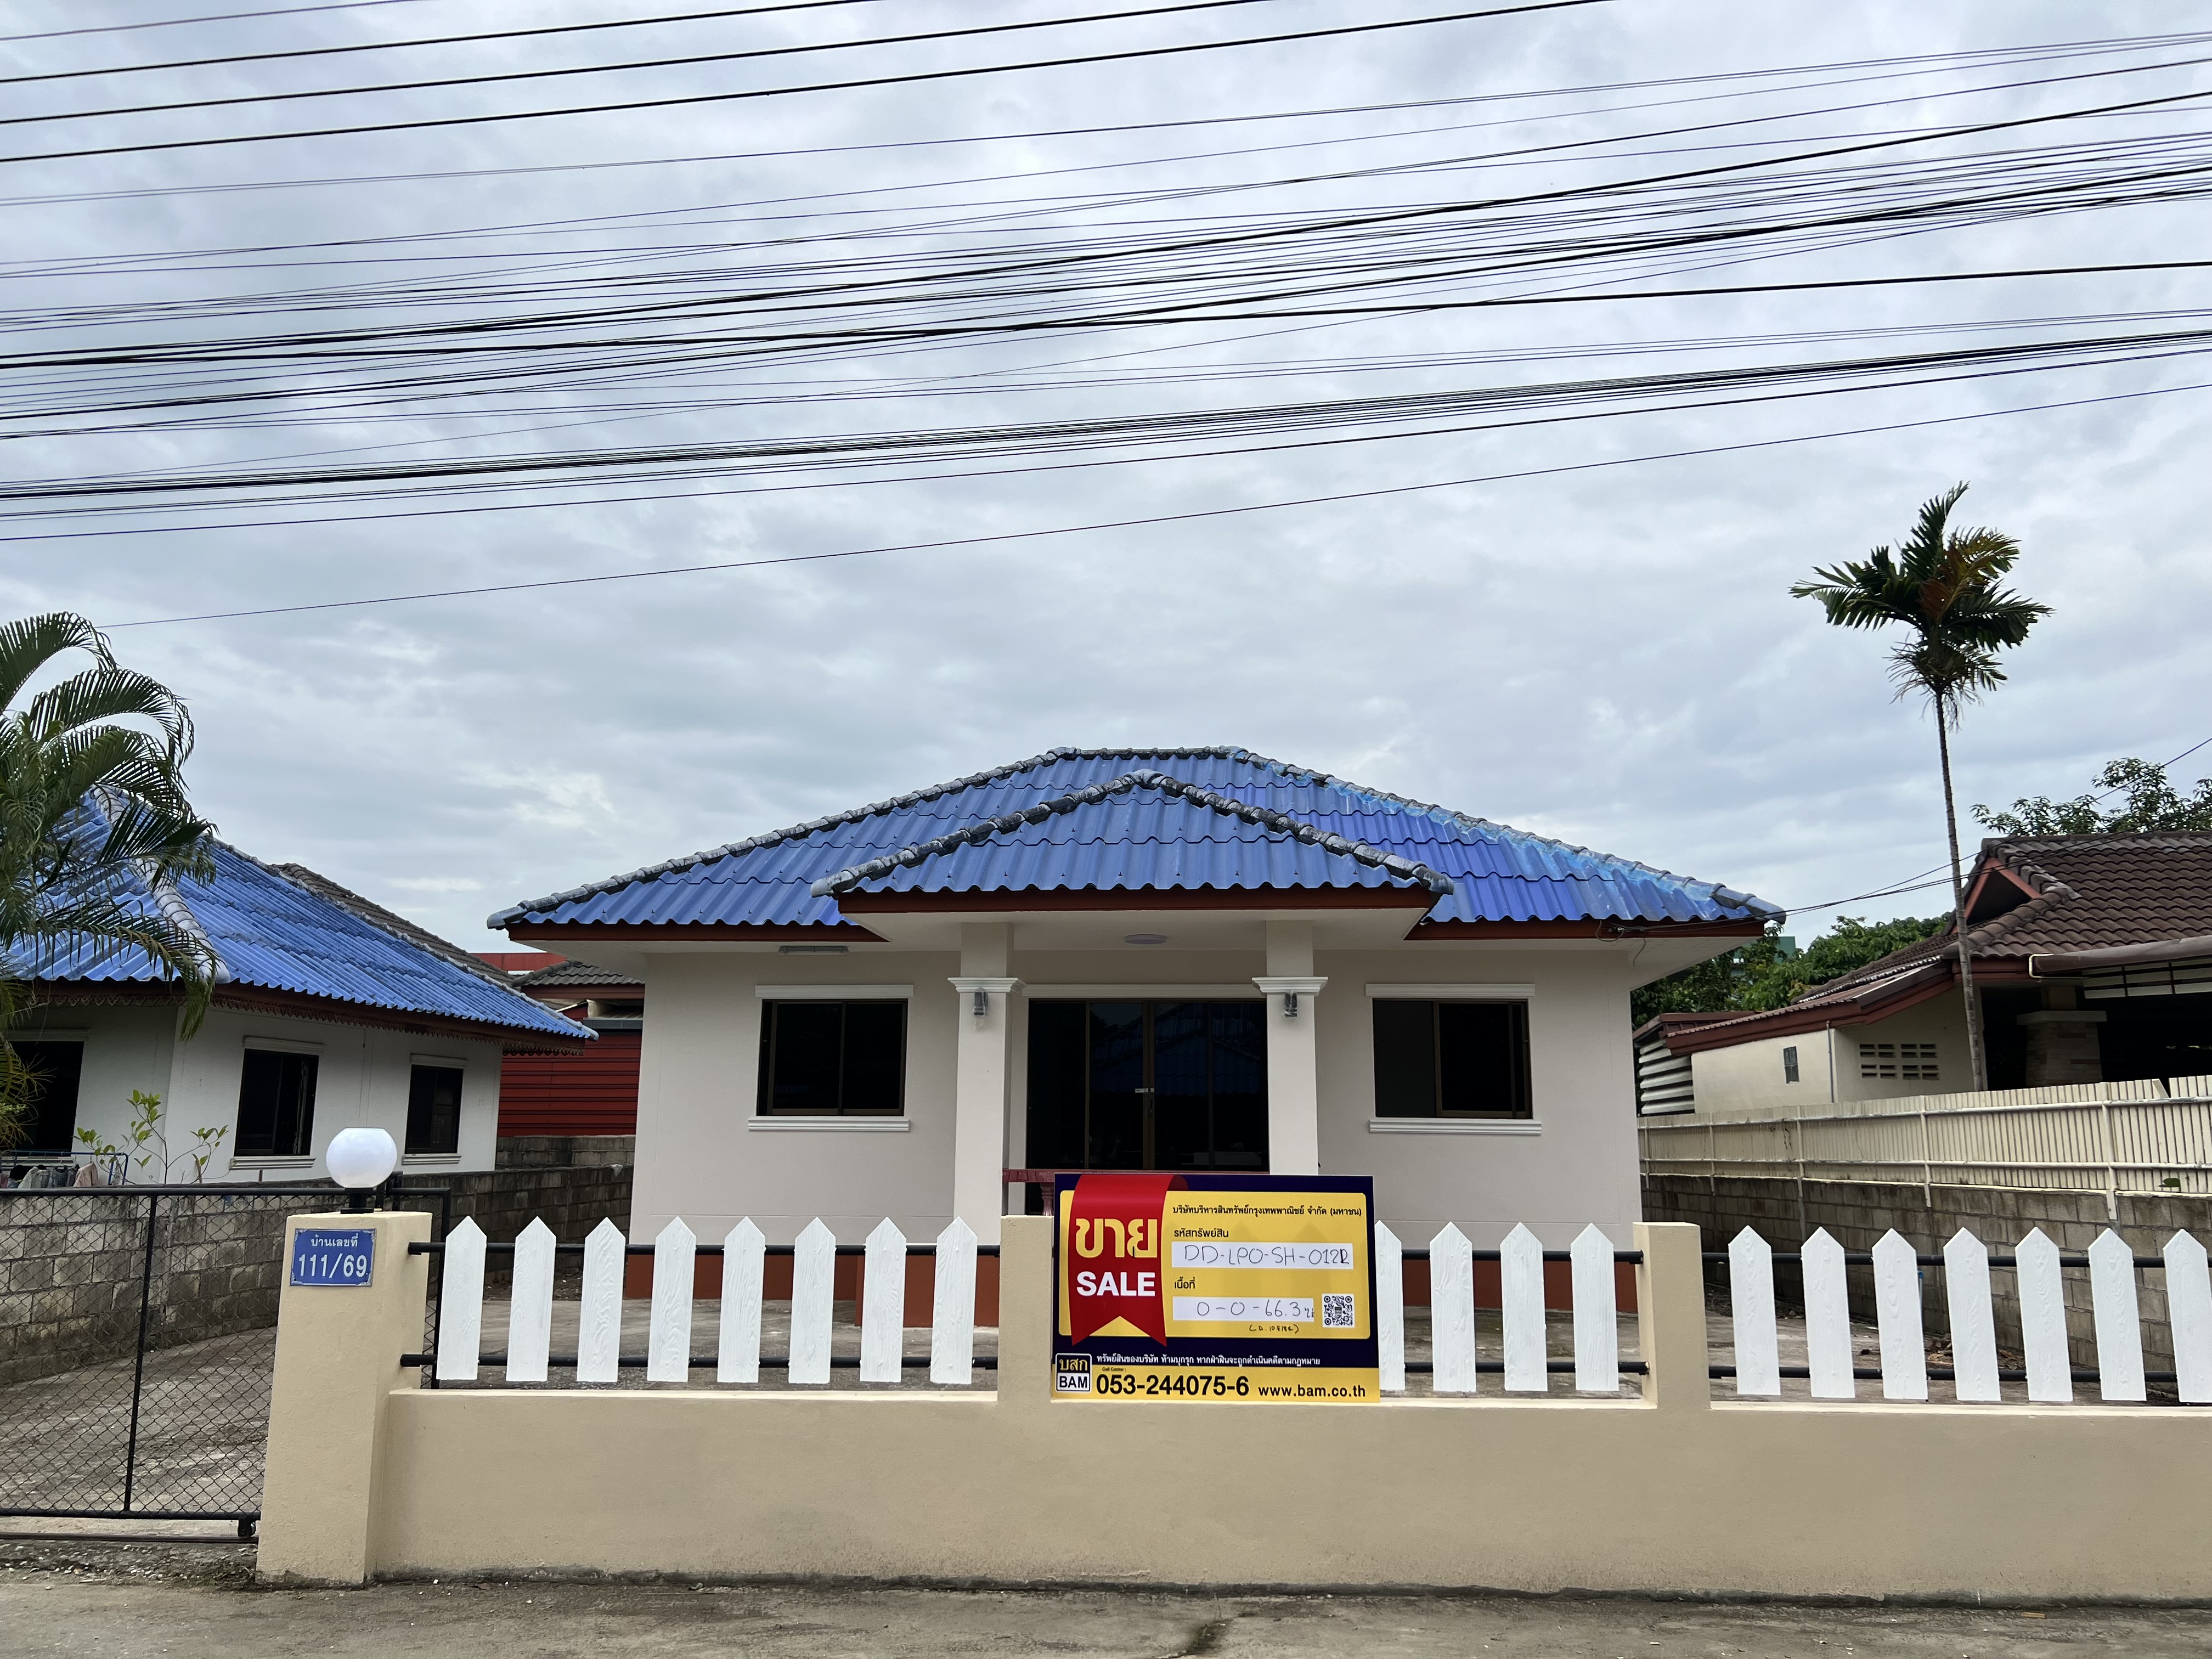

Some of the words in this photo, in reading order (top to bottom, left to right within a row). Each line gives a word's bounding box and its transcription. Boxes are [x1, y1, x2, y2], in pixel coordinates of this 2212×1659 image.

[1173, 1204, 1305, 1217] บริษัทบริหารสินทรัพย์กรุงเทพพาณิชย์
[1307, 1205, 1327, 1215] จำกัด
[1330, 1207, 1362, 1217] (มหาชน)
[1076, 1218, 1158, 1259] ขาย
[1173, 1227, 1229, 1238] รหัสทรัพย์สิน
[311, 1233, 358, 1247] บ้านเลขที่
[298, 1253, 368, 1278] 111/69
[1076, 1271, 1155, 1296] SALE
[1174, 1277, 1195, 1289] เนื้อที่
[1059, 1358, 1088, 1371] บสก
[1097, 1353, 1159, 1363] ทรัพย์สินของบริษัท
[1161, 1353, 1194, 1366] ห้ามบุกรุก
[1059, 1375, 1087, 1389] BAM
[1097, 1374, 1249, 1396] 053-244075-6
[1258, 1384, 1366, 1397] www.bam.co.th
